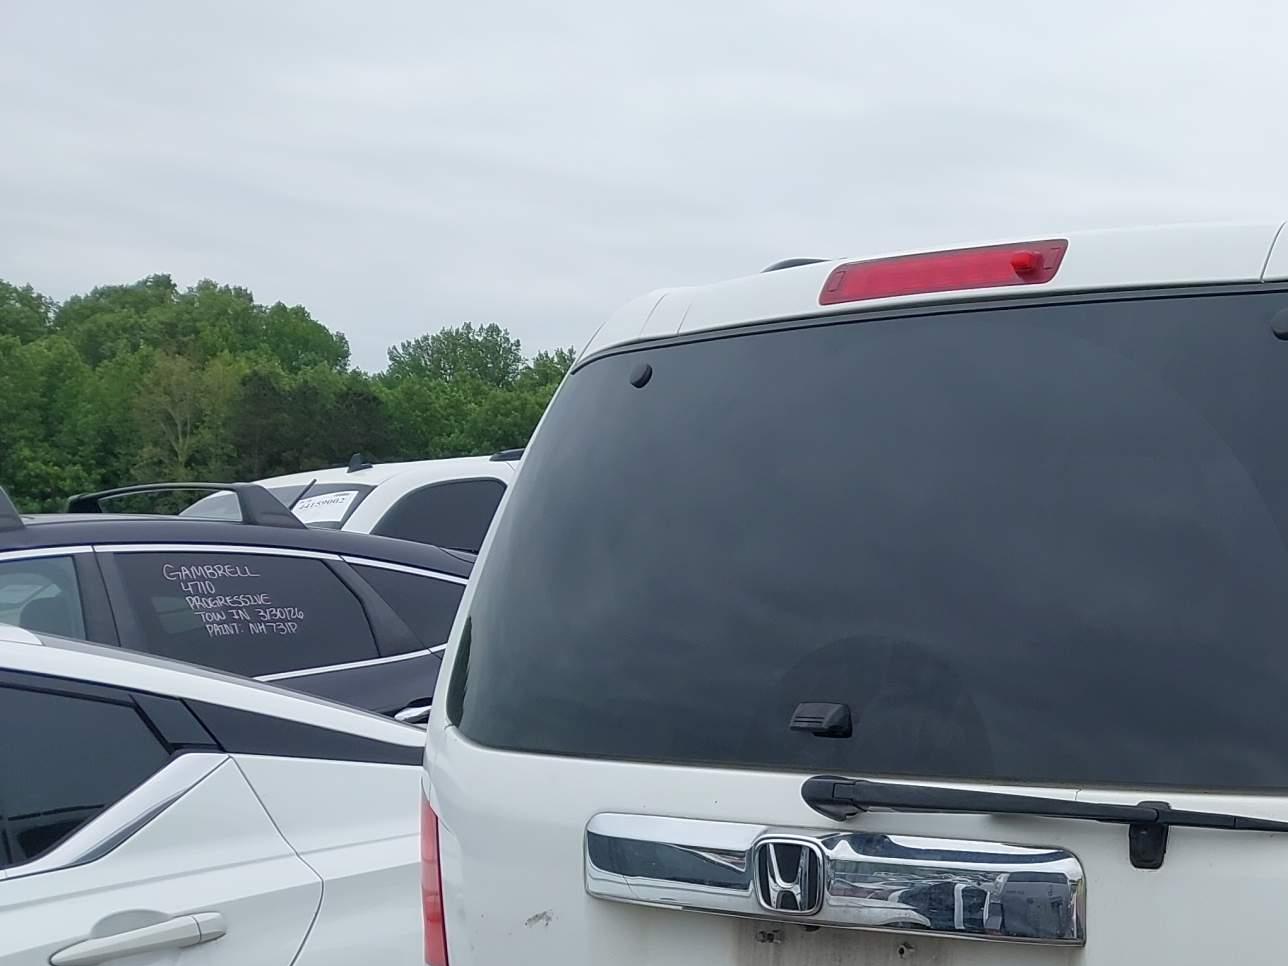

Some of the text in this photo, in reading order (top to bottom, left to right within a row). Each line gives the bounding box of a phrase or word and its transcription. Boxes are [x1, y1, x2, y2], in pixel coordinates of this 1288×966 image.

[162, 563, 262, 581] GAMBRELL
[180, 580, 217, 595] 4710
[185, 593, 273, 611] PROGRESSIVE
[193, 606, 305, 623] TOW IN 3/30/26
